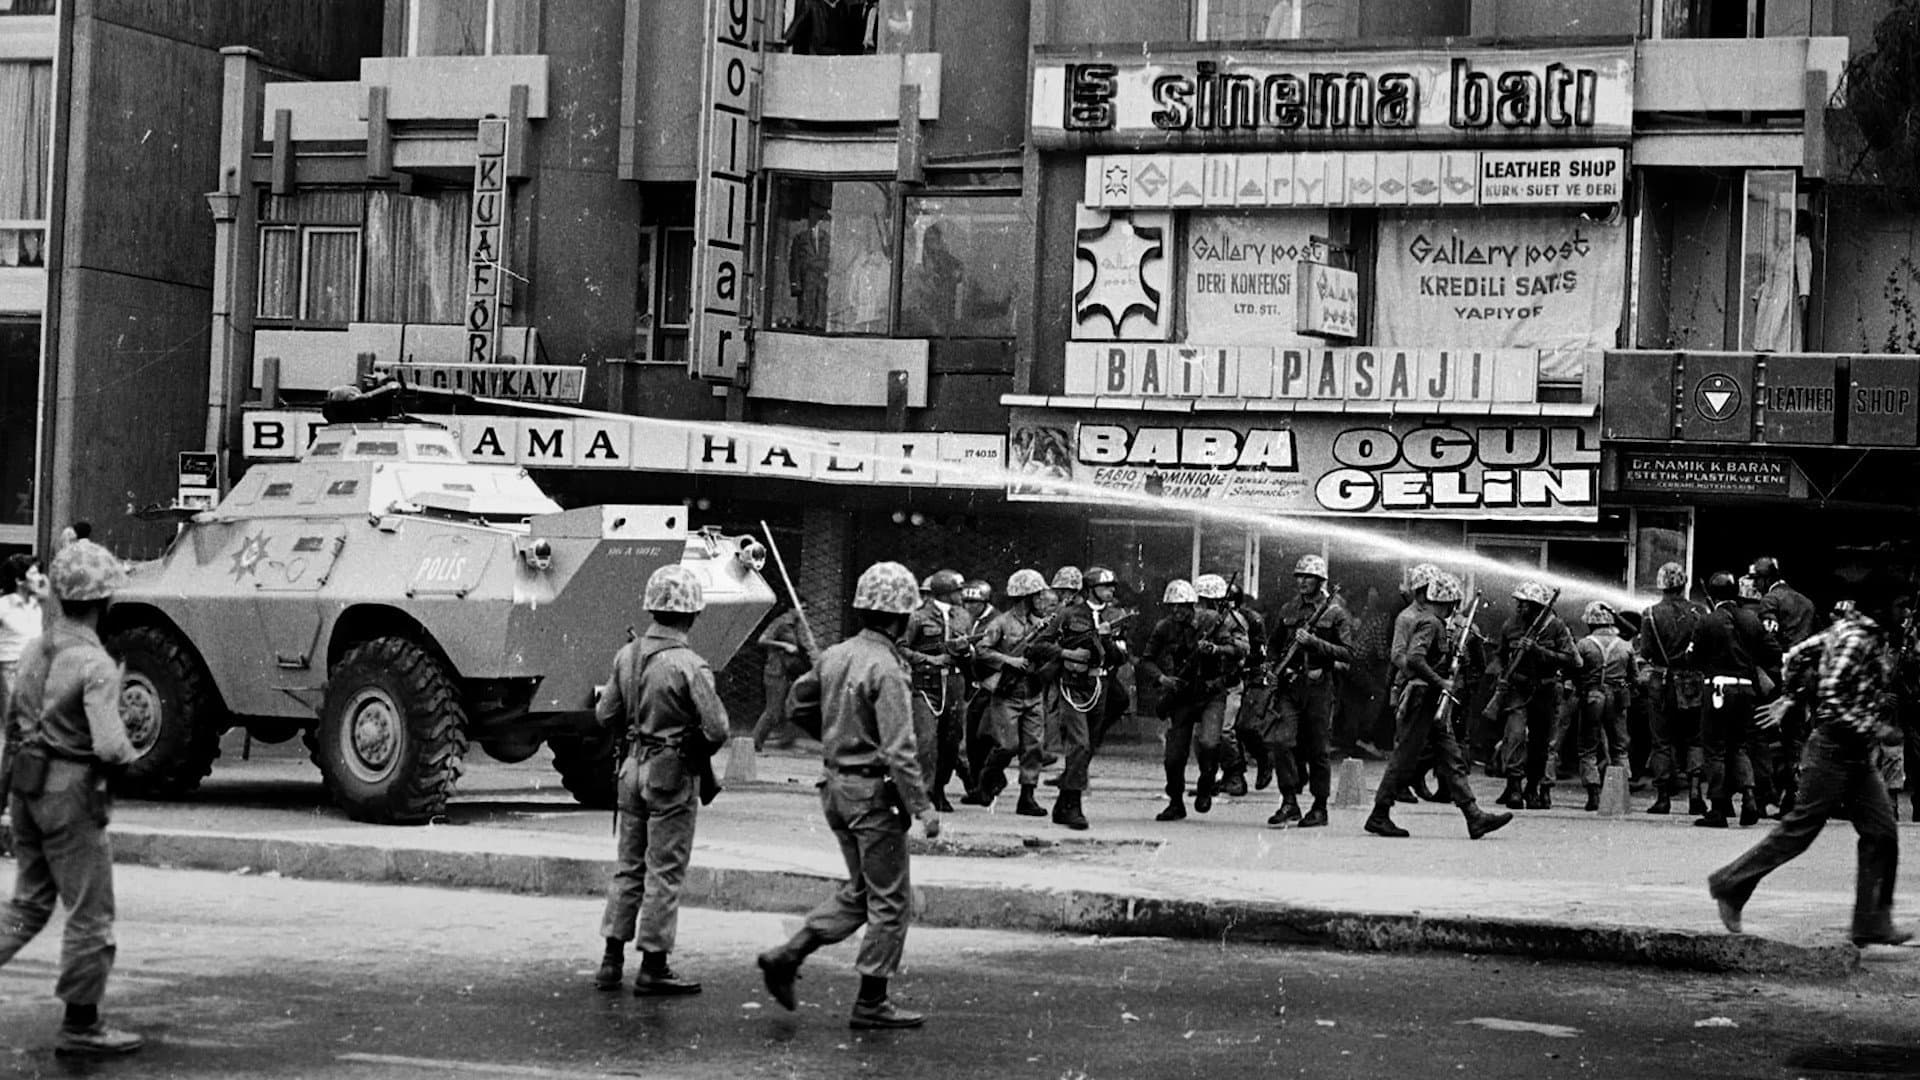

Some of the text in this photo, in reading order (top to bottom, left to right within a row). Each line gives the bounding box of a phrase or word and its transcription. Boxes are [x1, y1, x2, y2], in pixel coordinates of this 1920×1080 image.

[1152, 62, 1420, 130] sinema
[1485, 160, 1616, 178] LEATHER SHOP
[1566, 183, 1581, 196] VE
[1408, 229, 1590, 267] Gallary post
[1108, 348, 1482, 398] BATI PASAJI
[1766, 386, 1911, 414] LEATHER SHOP
[253, 419, 619, 459] BAMA
[1078, 417, 1600, 472] BABA OĞUL
[1094, 468, 1137, 481] FABIO
[1654, 460, 1705, 472] NAMIK
[1726, 461, 1781, 473] BARAN
[1315, 467, 1598, 512] GELİN
